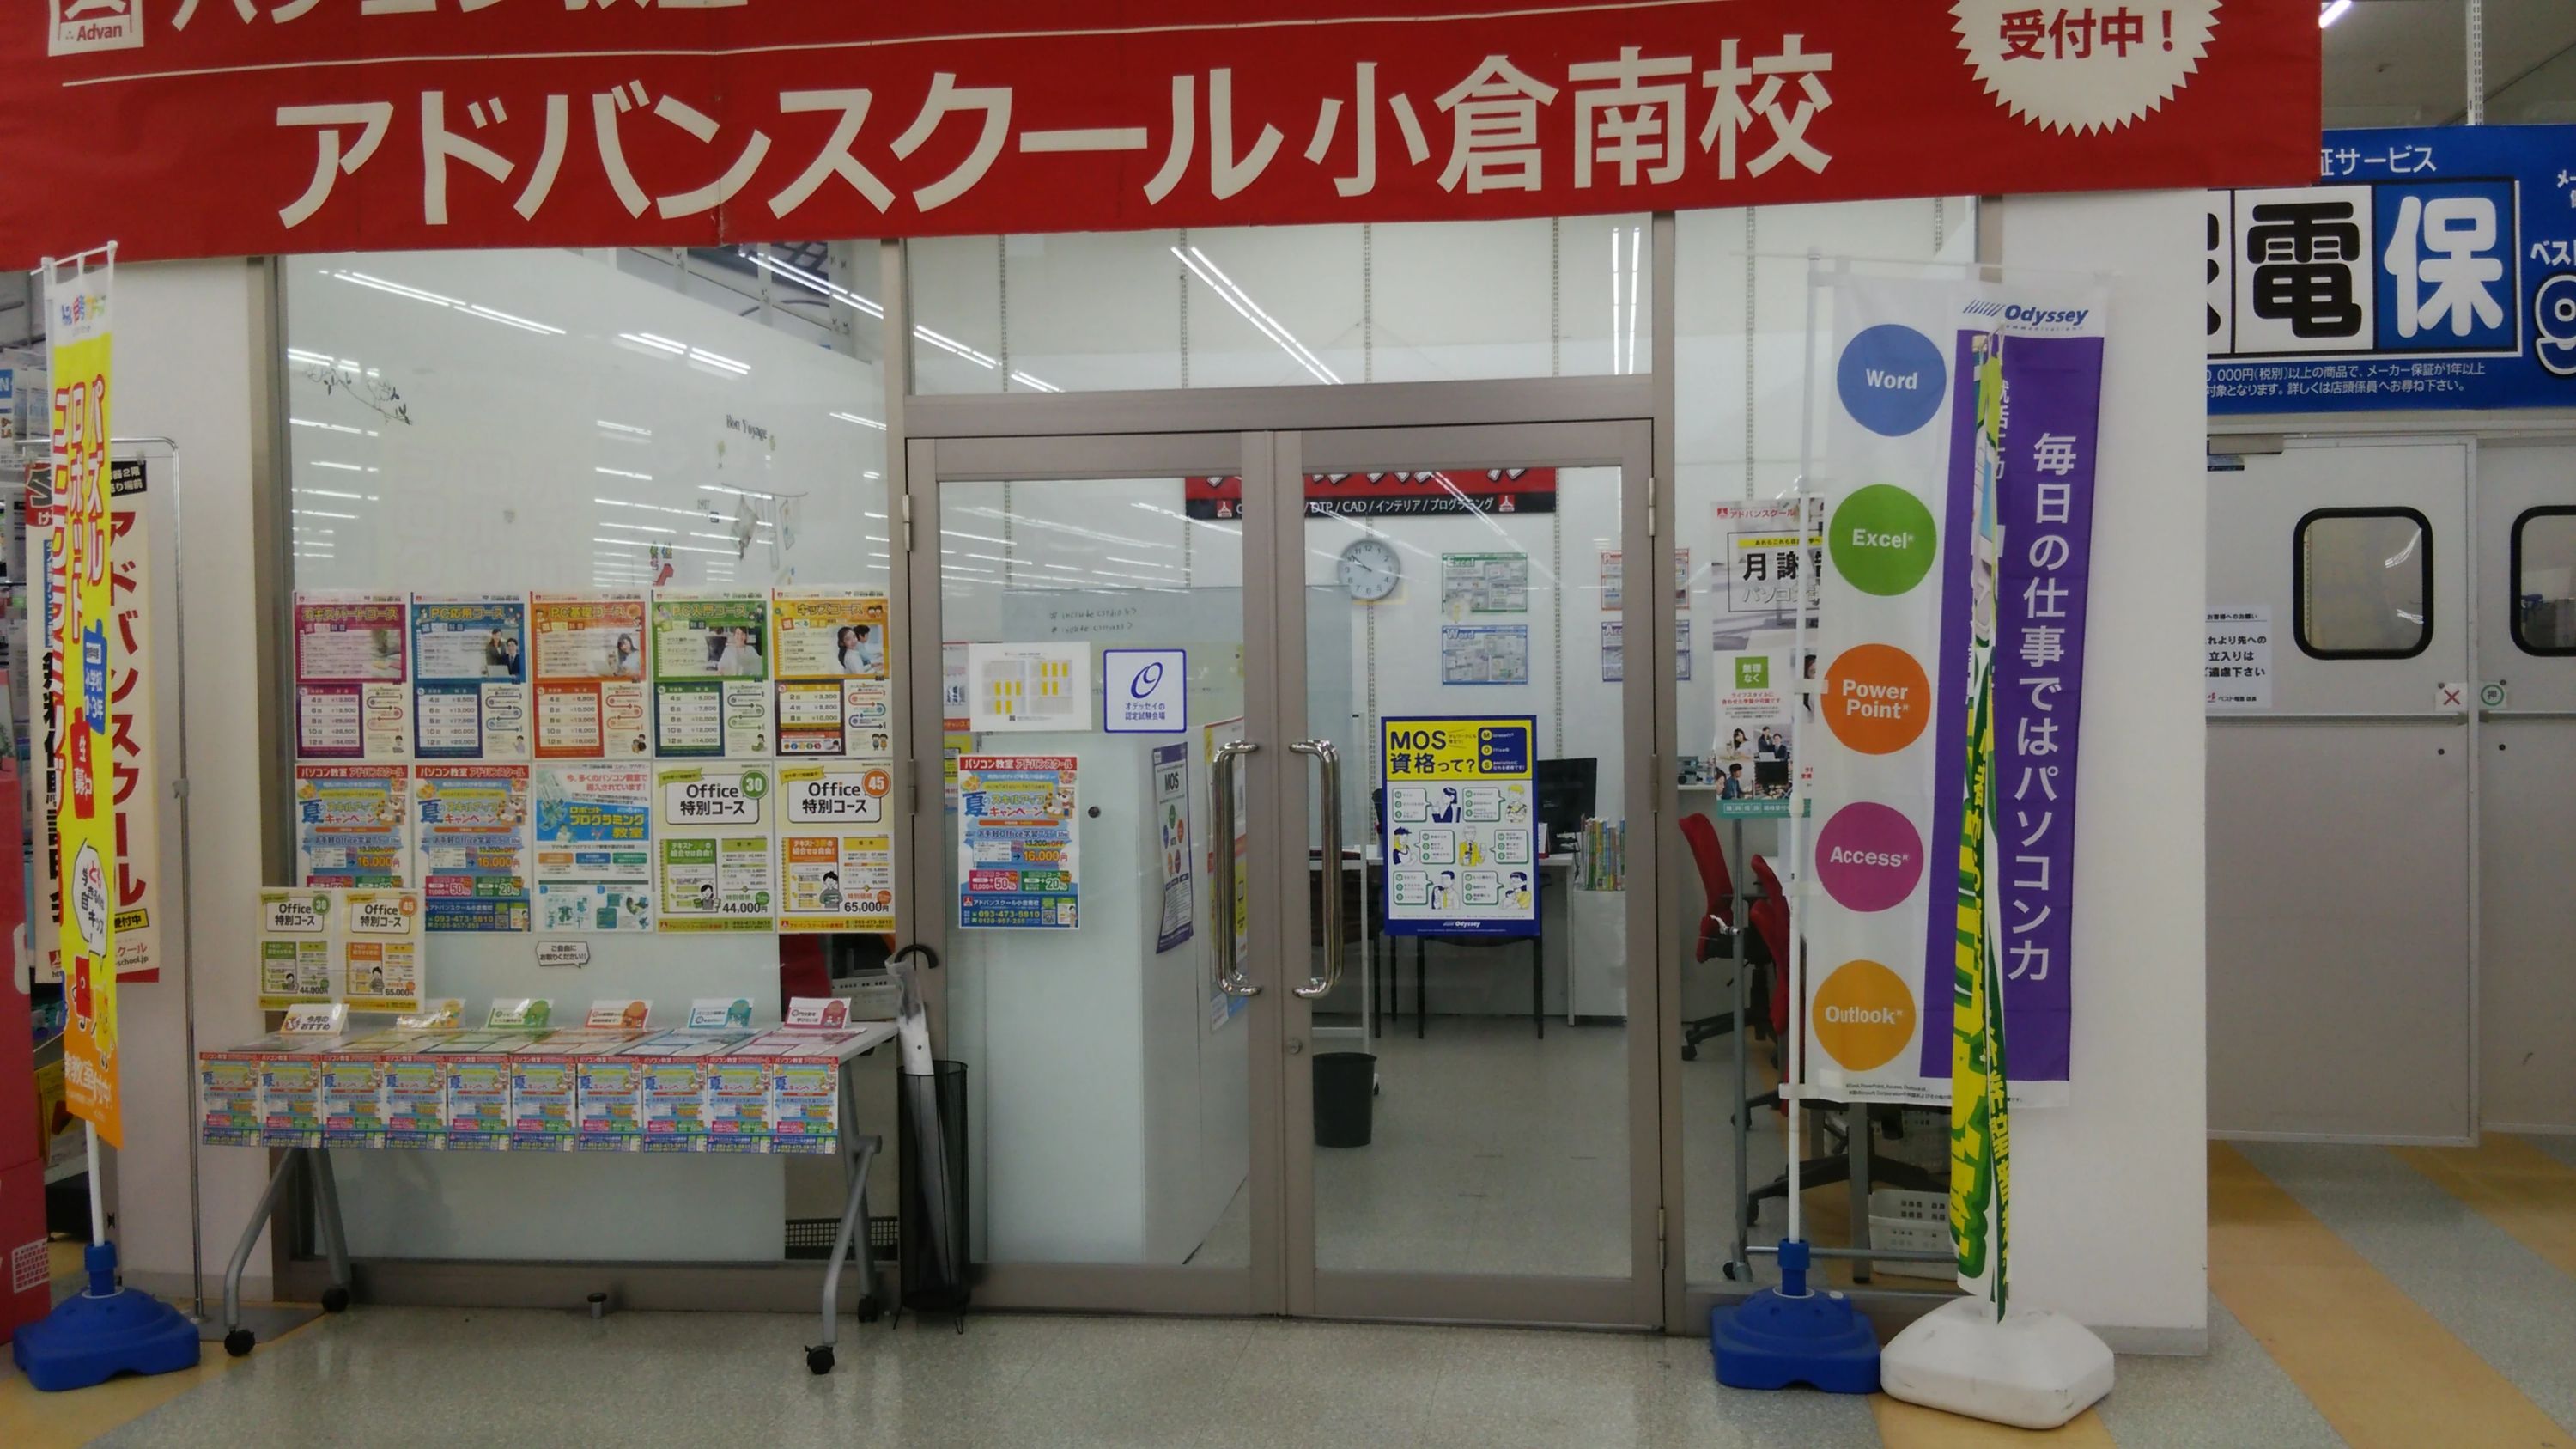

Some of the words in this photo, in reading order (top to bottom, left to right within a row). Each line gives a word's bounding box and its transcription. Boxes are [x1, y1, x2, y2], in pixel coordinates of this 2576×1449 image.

[76, 23, 123, 41] Advan
[276, 33, 1834, 229] アドバンスクール小倉南校
[2207, 196, 2504, 338] 電保
[2004, 304, 2089, 326] Odyssey
[1866, 368, 1918, 391] Word
[1343, 502, 1367, 513] CAD
[1376, 500, 1421, 512] インテリア
[1431, 497, 1494, 511] プログラミング
[303, 606, 398, 620] エキスパートコース
[431, 606, 504, 619] PC応用コース
[672, 605, 749, 618] PC入門コース
[1446, 628, 1475, 640] Word
[2206, 636, 2267, 645] れより先への
[2208, 651, 2255, 661] 立入りは
[1744, 674, 1759, 683] なく
[1842, 679, 1908, 700] Power
[1125, 702, 1165, 711] オデッセイの
[2008, 432, 2077, 981] 毎日の仕事ではパソコン力
[1125, 711, 1165, 721] 認定試験会場
[1390, 730, 1446, 750] MOS
[964, 759, 1012, 769] パソコン教室
[1390, 752, 1475, 774] 資格って?
[301, 768, 348, 777] パソコン教室
[421, 768, 467, 777] パソコン教室
[746, 778, 762, 791] 30
[868, 776, 885, 791] 45
[1164, 773, 1179, 792] MOS
[687, 783, 738, 798] Office
[809, 782, 860, 797] Office
[680, 801, 744, 816] 特別コース
[803, 799, 866, 814] 特別コース
[570, 815, 644, 825] プログラミング
[612, 827, 643, 838] 教室
[279, 904, 312, 914] Office
[365, 904, 398, 915] Office
[722, 903, 768, 914] 44,000円
[844, 902, 889, 913] 65,000円
[275, 915, 315, 926] 特別コース
[360, 916, 402, 928] 特別コース
[116, 944, 148, 956] クール
